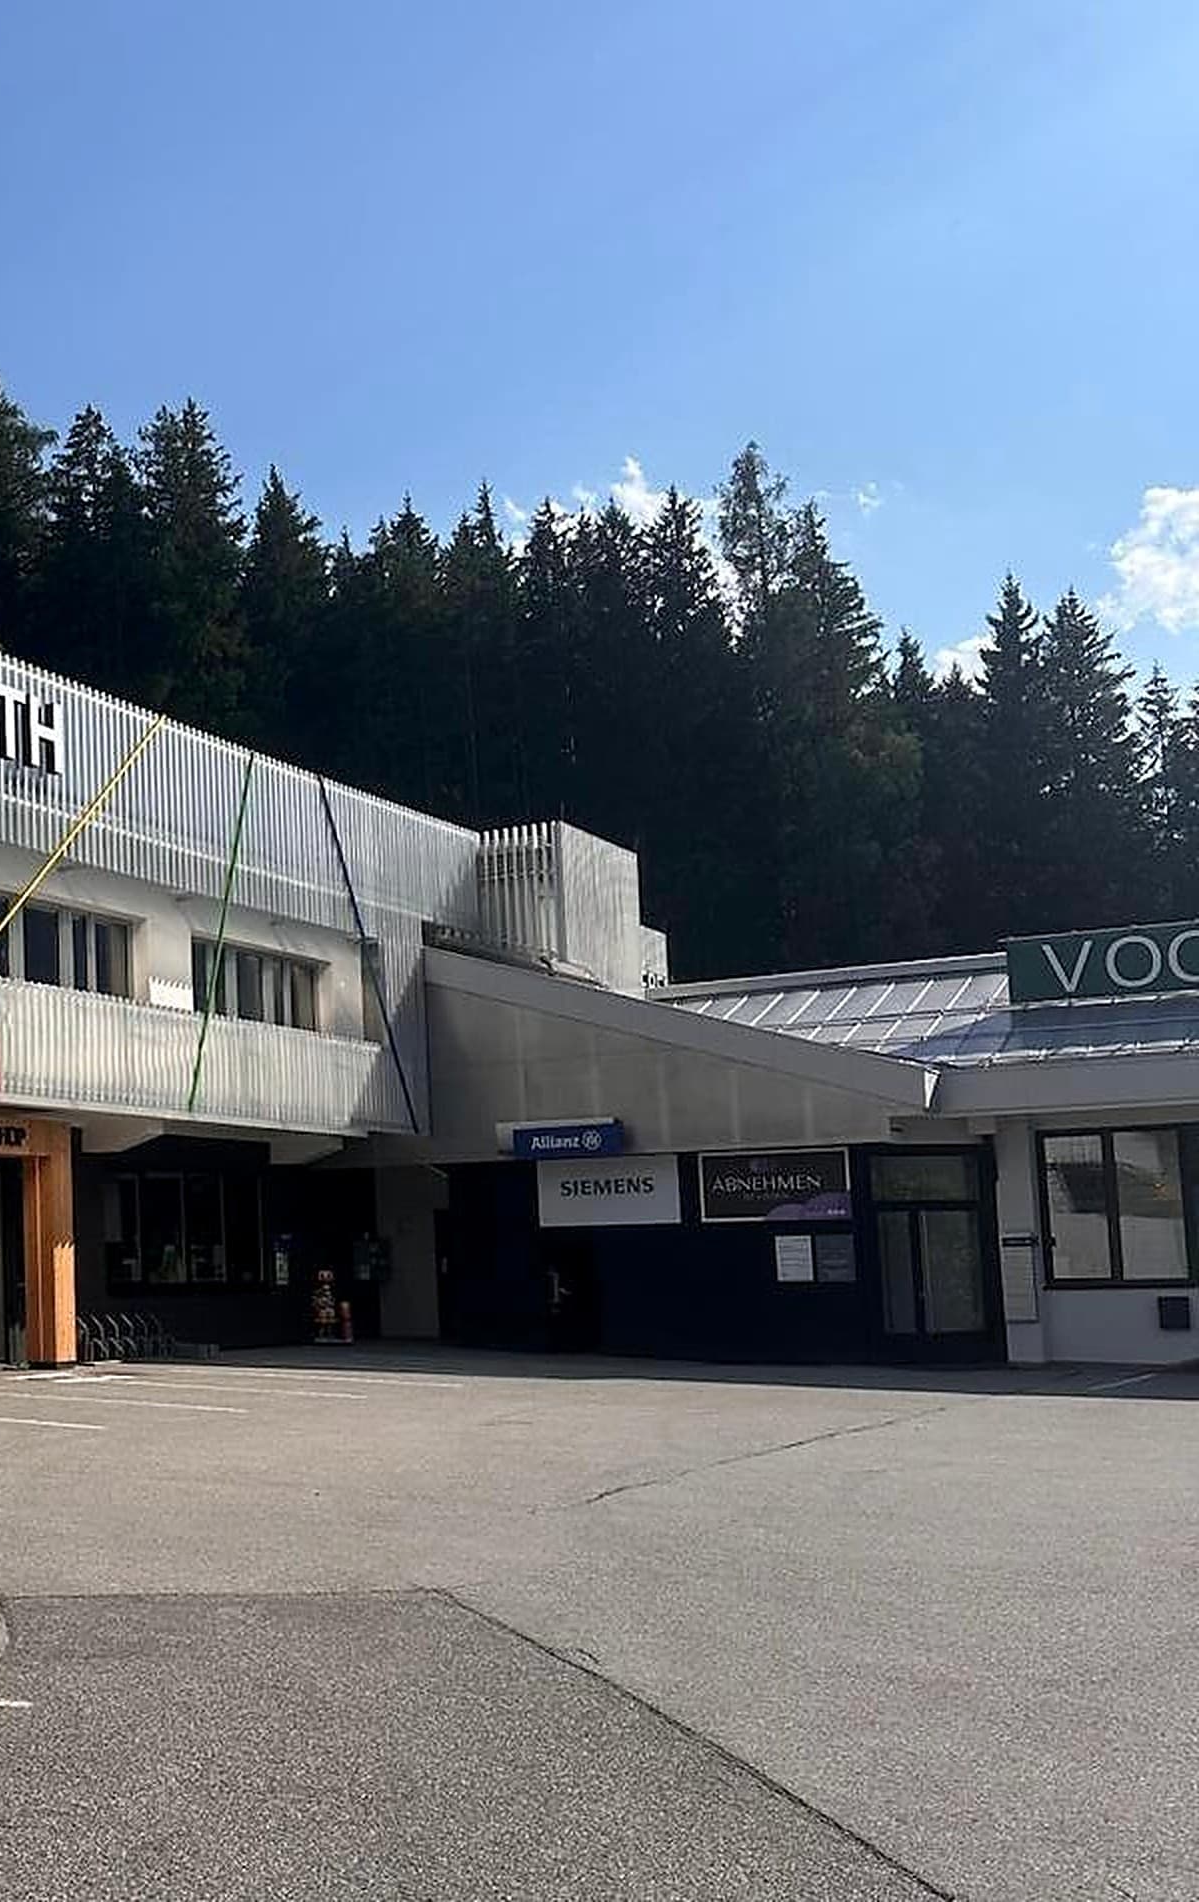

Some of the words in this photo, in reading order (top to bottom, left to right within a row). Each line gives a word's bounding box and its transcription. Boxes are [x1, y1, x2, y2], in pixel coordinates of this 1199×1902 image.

[530, 1135, 581, 1150] Allianz
[559, 1176, 655, 1198] SIEMENS
[711, 1174, 822, 1193] ABNEHMEN
